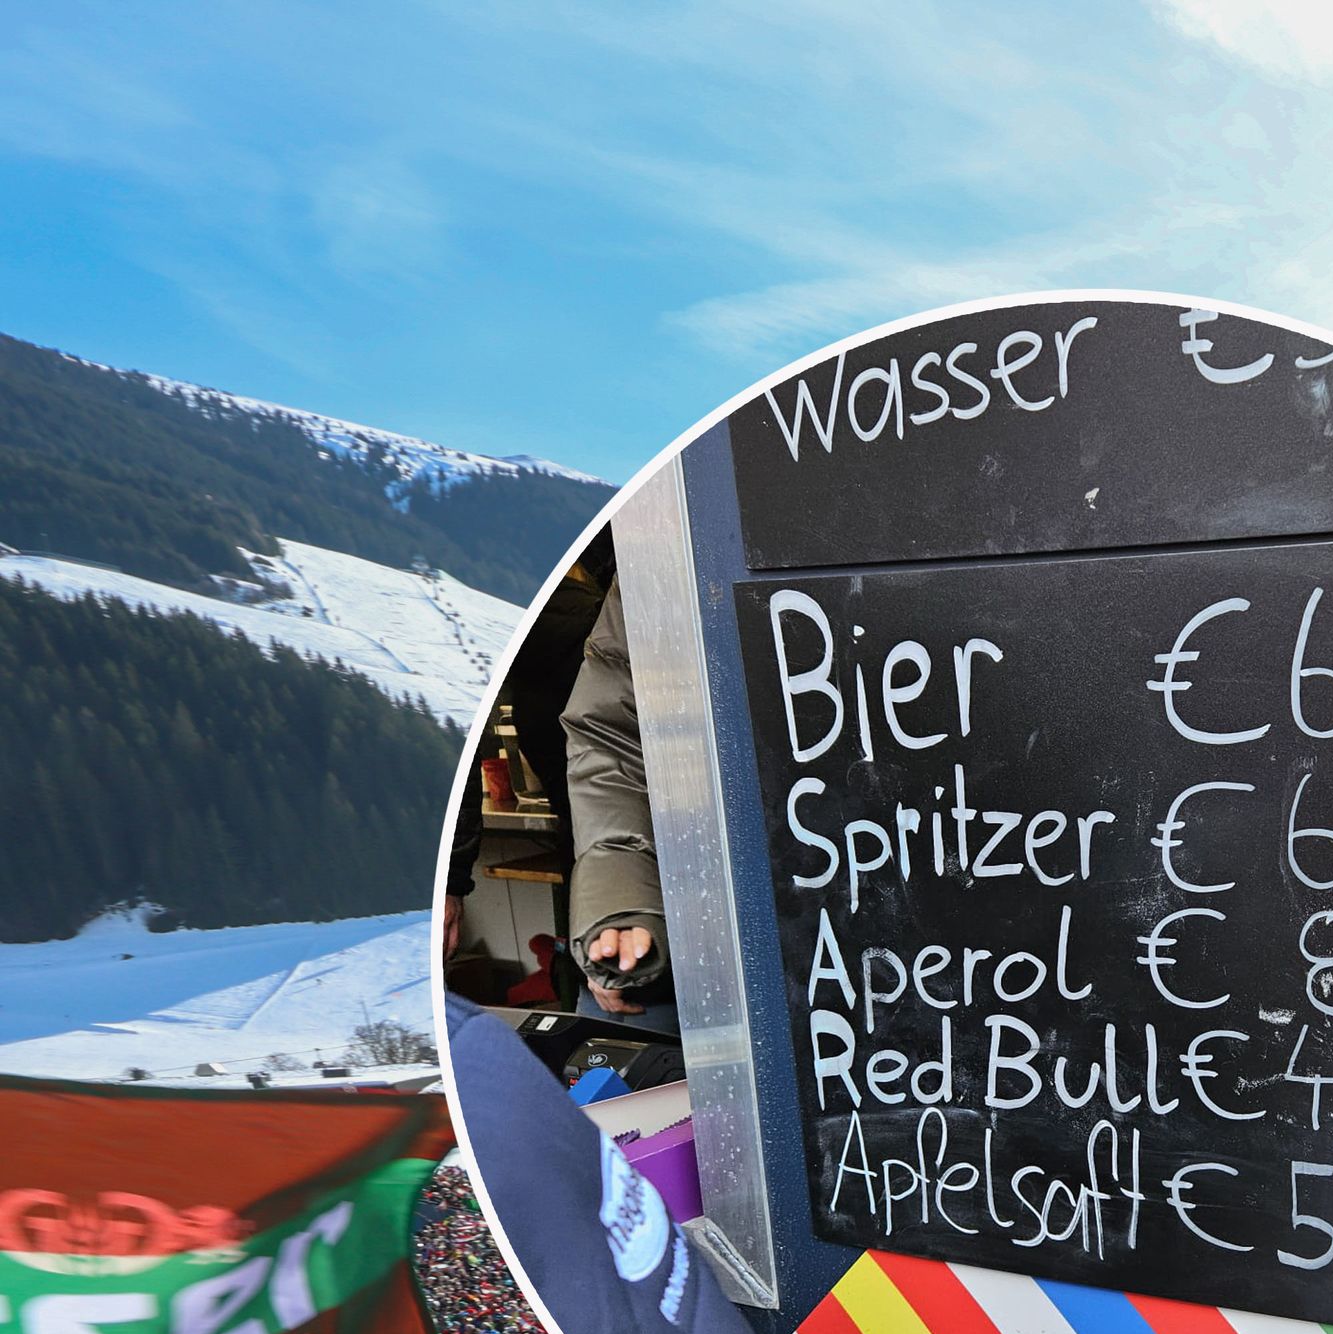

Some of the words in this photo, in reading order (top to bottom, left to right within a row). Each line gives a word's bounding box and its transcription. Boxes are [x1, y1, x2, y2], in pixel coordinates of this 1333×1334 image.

[766, 317, 1098, 461] Wasser
[770, 589, 1003, 762] Bier
[1146, 597, 1272, 744] €
[786, 764, 1117, 913] Spritzer
[1151, 781, 1255, 893] €
[808, 906, 1092, 1033] Aperol
[1136, 908, 1230, 1008] €
[809, 1009, 952, 1111] Red
[984, 1015, 1180, 1115] Bull
[1179, 1031, 1266, 1119] €
[830, 1107, 1145, 1260] Apfelsaft
[1163, 1162, 1254, 1253] €
